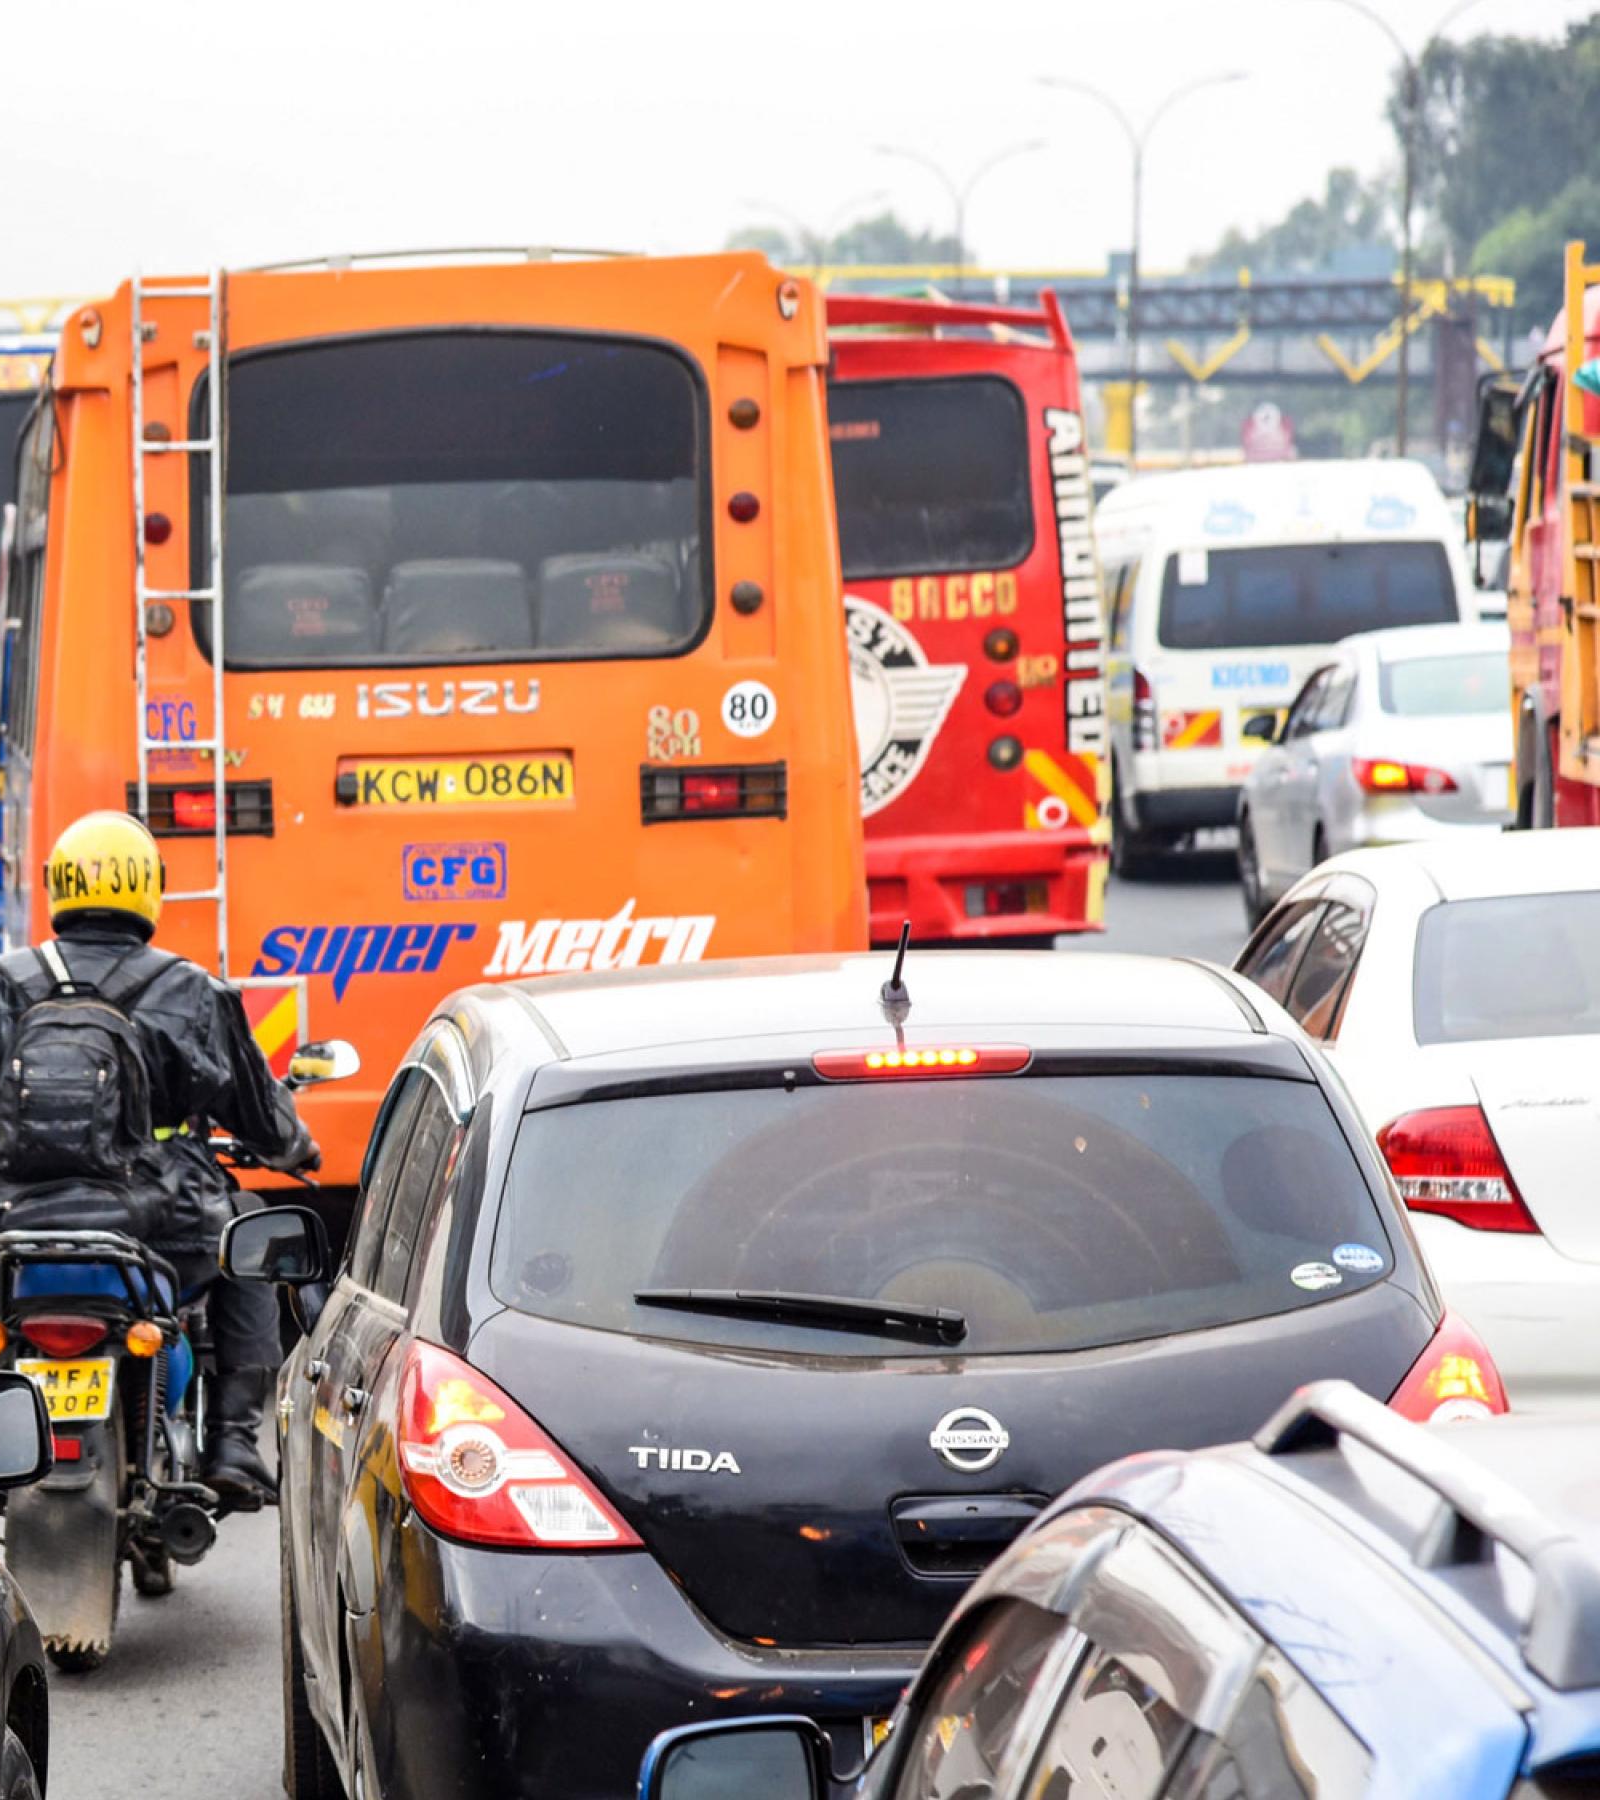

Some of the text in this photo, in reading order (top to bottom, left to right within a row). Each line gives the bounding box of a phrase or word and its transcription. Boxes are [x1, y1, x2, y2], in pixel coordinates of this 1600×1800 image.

[889, 571, 1017, 623] SACCO
[357, 679, 541, 719] ISUZU
[729, 693, 769, 720] 80
[145, 701, 197, 742] CFG
[647, 705, 700, 739] 80
[362, 762, 565, 804] KCW 086N
[412, 856, 496, 886] CFG
[41, 1368, 102, 1390] MFA
[45, 1395, 100, 1412] 30P
[939, 1434, 1002, 1444] NISSAN
[628, 1446, 742, 1473] TIIDA
